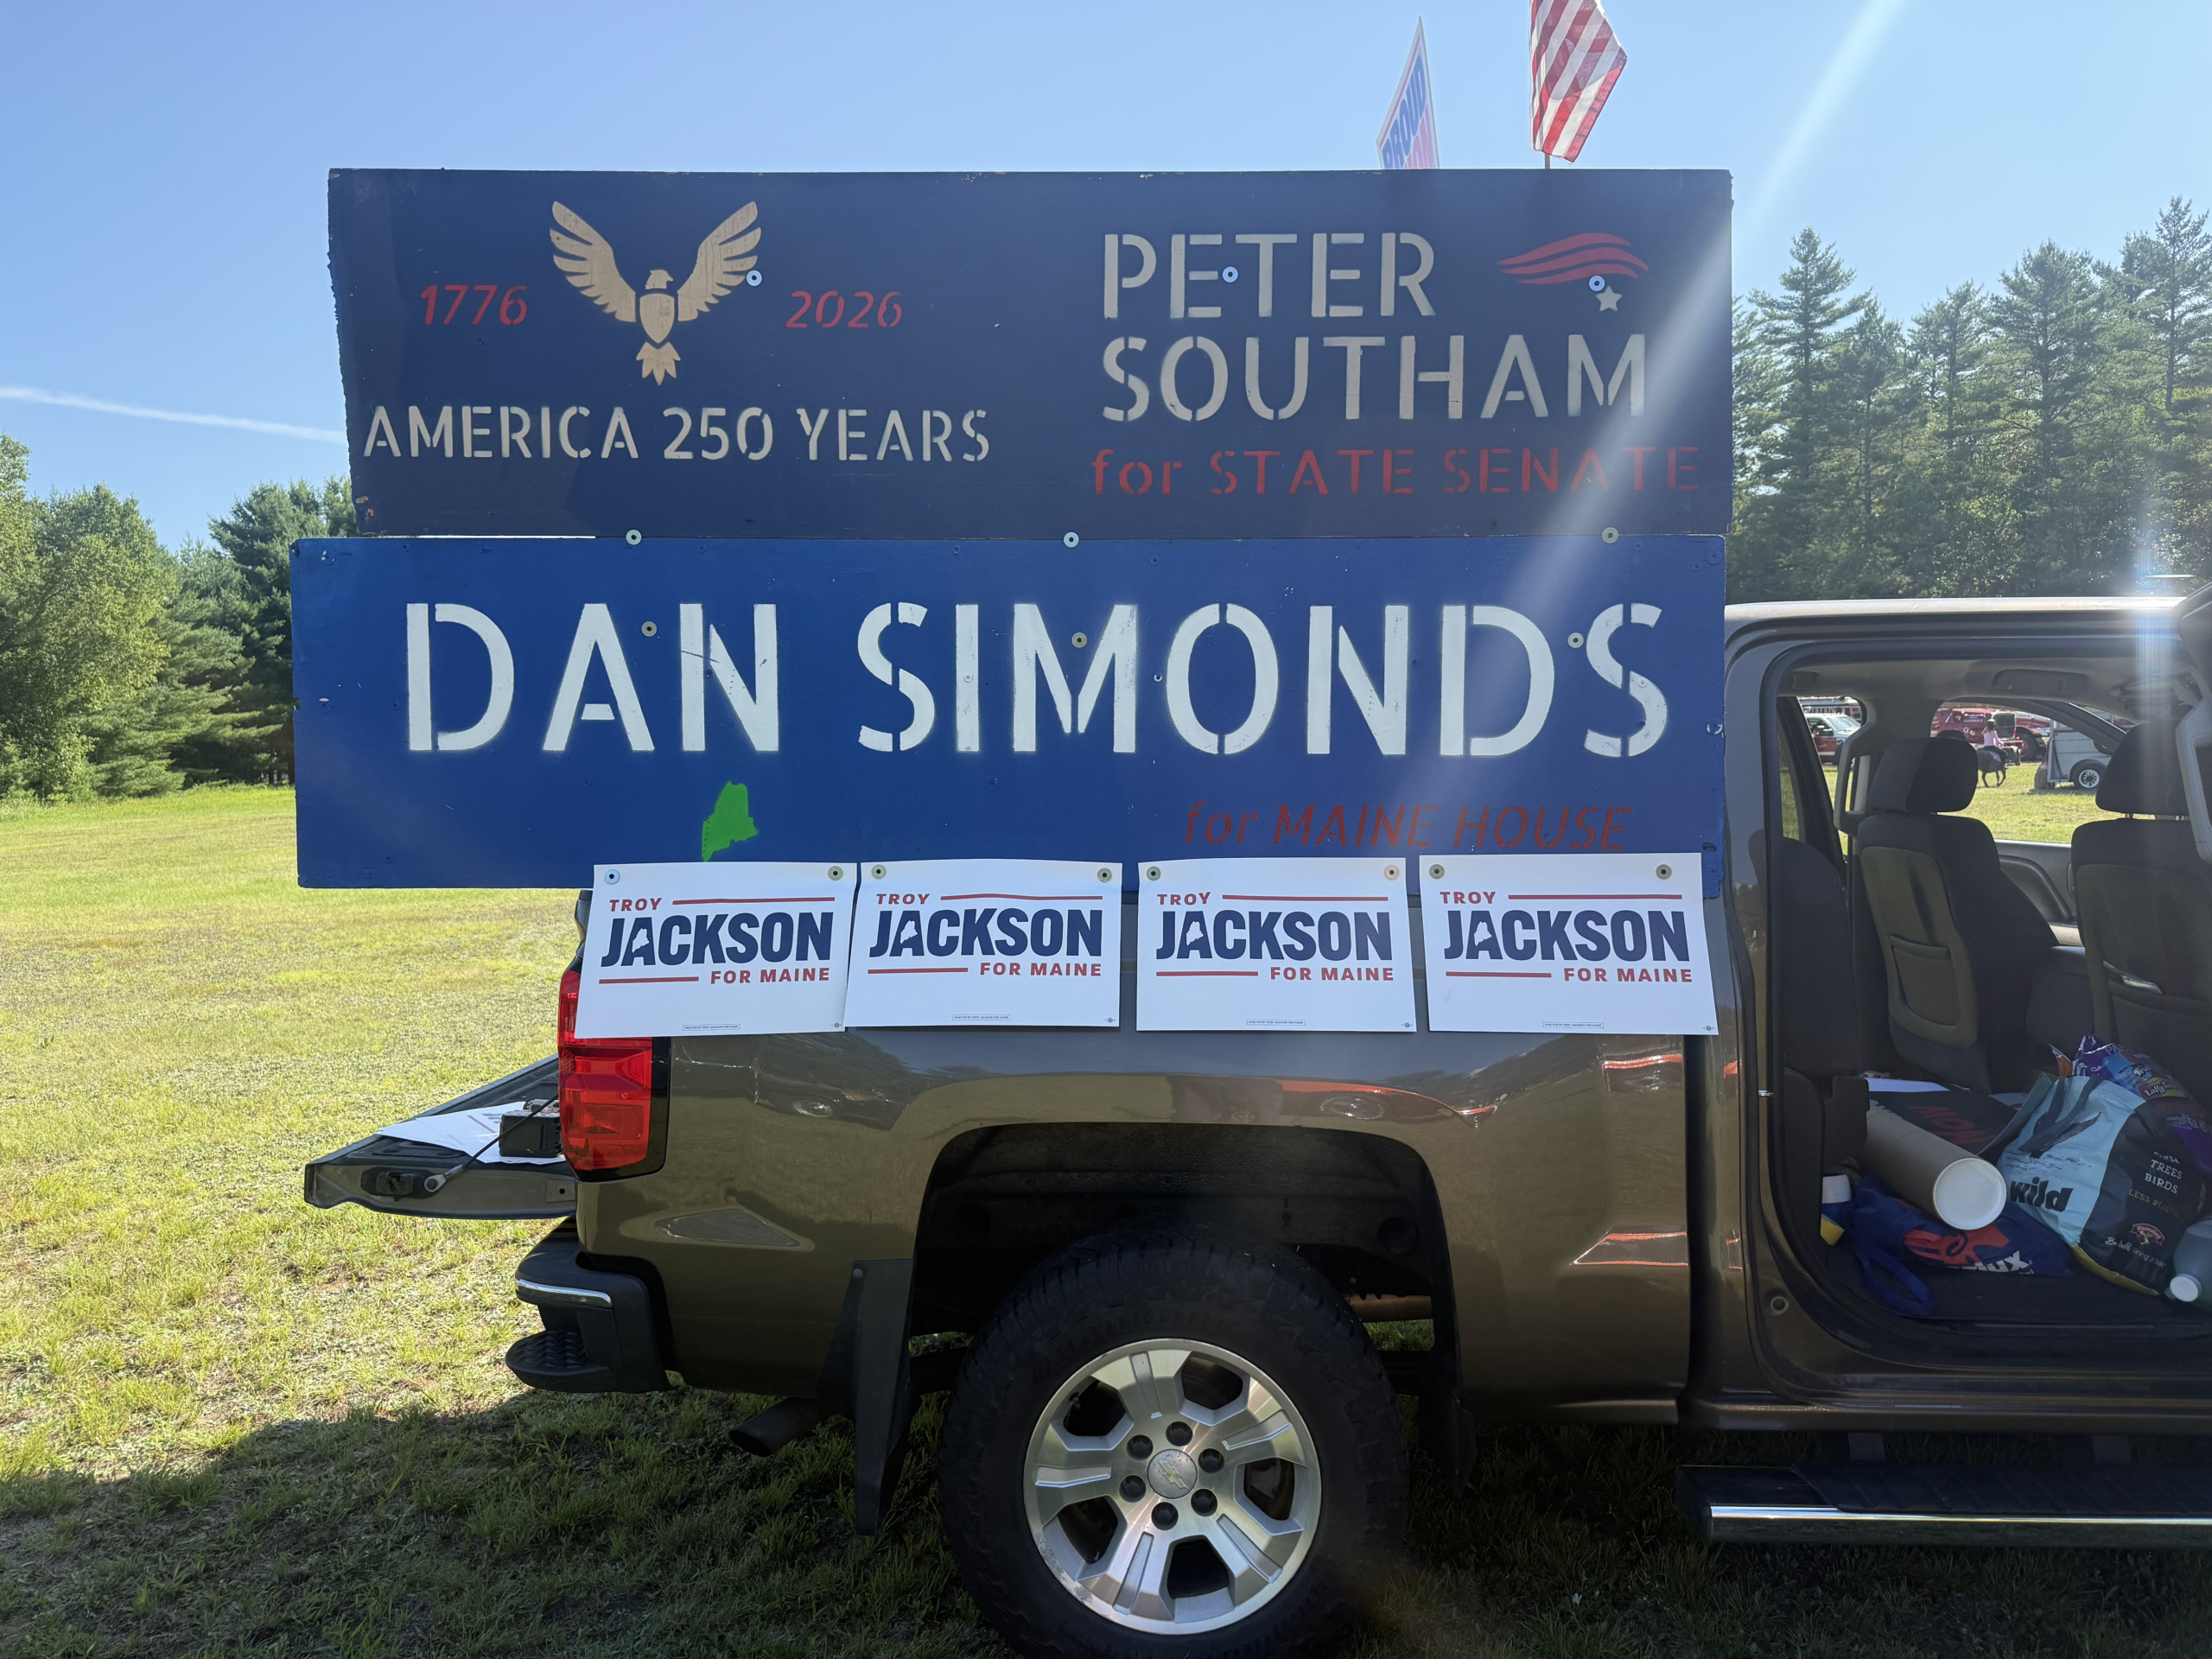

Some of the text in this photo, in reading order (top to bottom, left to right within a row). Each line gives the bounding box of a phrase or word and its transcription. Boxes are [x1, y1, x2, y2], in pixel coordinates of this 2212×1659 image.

[1103, 232, 1435, 319] PETER
[420, 283, 528, 326] 1776
[785, 290, 903, 328] 2026
[1102, 334, 1645, 422] SOUTHAM
[363, 405, 990, 462] AMERICA 250 YEARS
[1091, 446, 1700, 496] for STATE SENATE
[404, 601, 1669, 759] DAN SIMONDS
[1185, 800, 1633, 851] for MAINE HOUSE
[609, 898, 662, 912] TROY
[876, 893, 931, 906] TROY
[1157, 892, 1211, 906] TROY
[1440, 891, 1497, 905] TROY
[601, 912, 835, 968] JACKSON
[868, 907, 1103, 958] JACKSON
[1155, 910, 1393, 961] JACKSON
[1444, 909, 1690, 962] JACKSON
[710, 967, 830, 984] FOR MAINE
[979, 962, 1103, 977] FOR MAINE
[1269, 966, 1394, 982] FOR MAINE
[1563, 967, 1693, 983] FOR MAINE
[2144, 1173, 2178, 1194] BIRDS
[2150, 1159, 2183, 1180] TREES
[2010, 1176, 2074, 1212] wild
[2128, 1188, 2151, 1205] LESS
